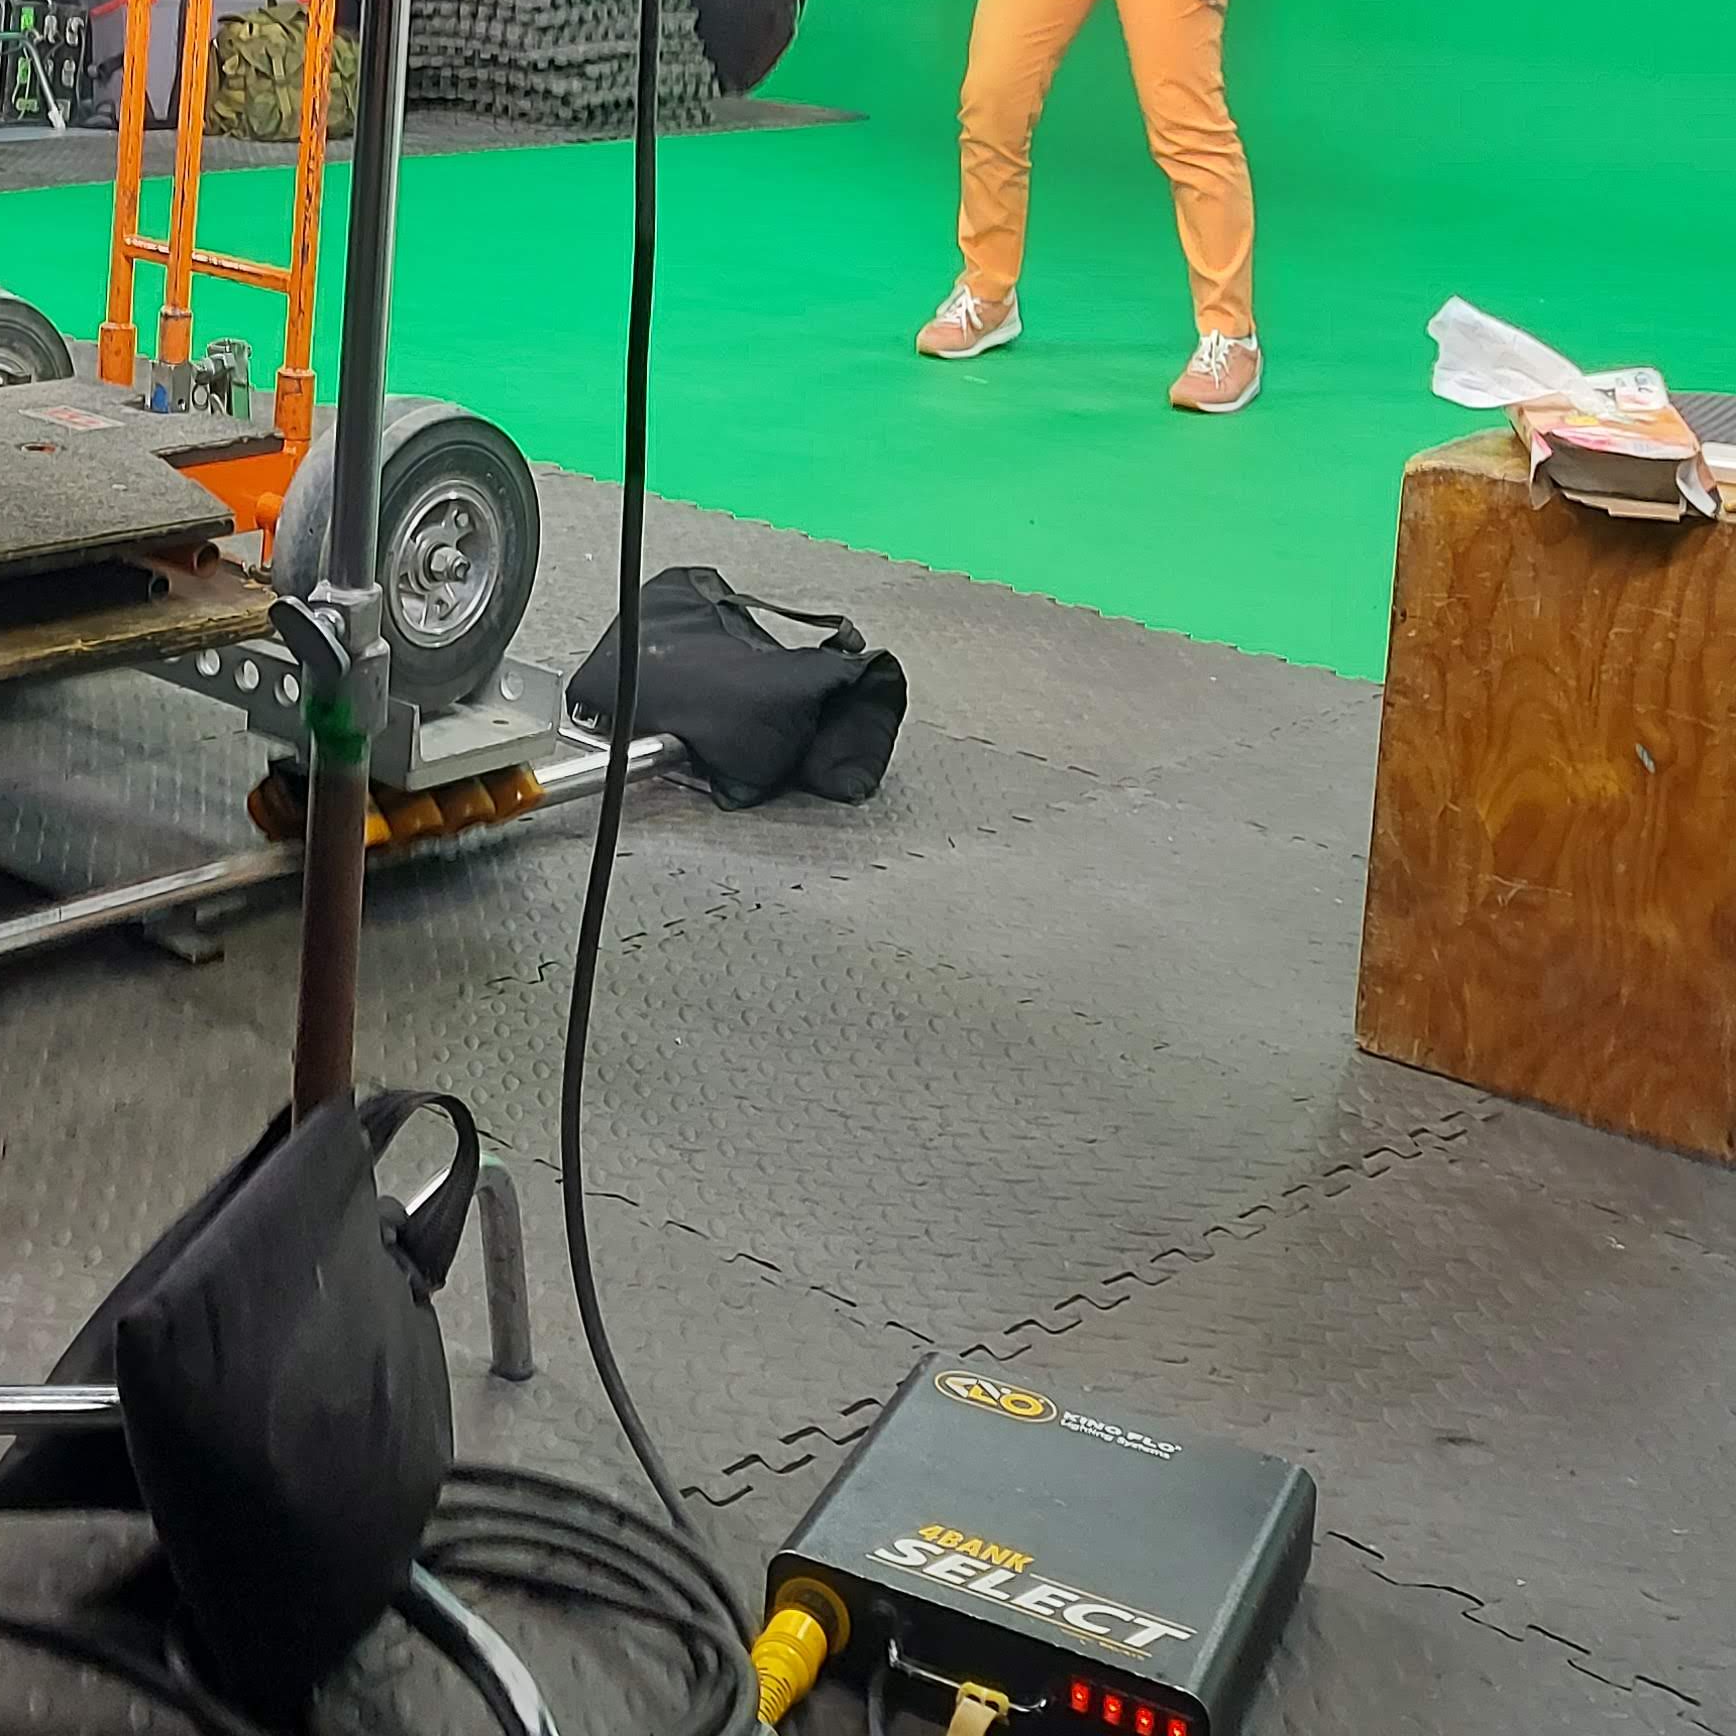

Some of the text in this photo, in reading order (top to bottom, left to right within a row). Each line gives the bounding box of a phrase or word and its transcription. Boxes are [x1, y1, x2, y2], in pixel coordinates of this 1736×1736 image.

[1060, 1418, 1171, 1460] Lighting Systems
[1063, 1410, 1123, 1435] KINO
[918, 1522, 1035, 1573] 4BANK
[873, 1537, 1192, 1648] SELECT
